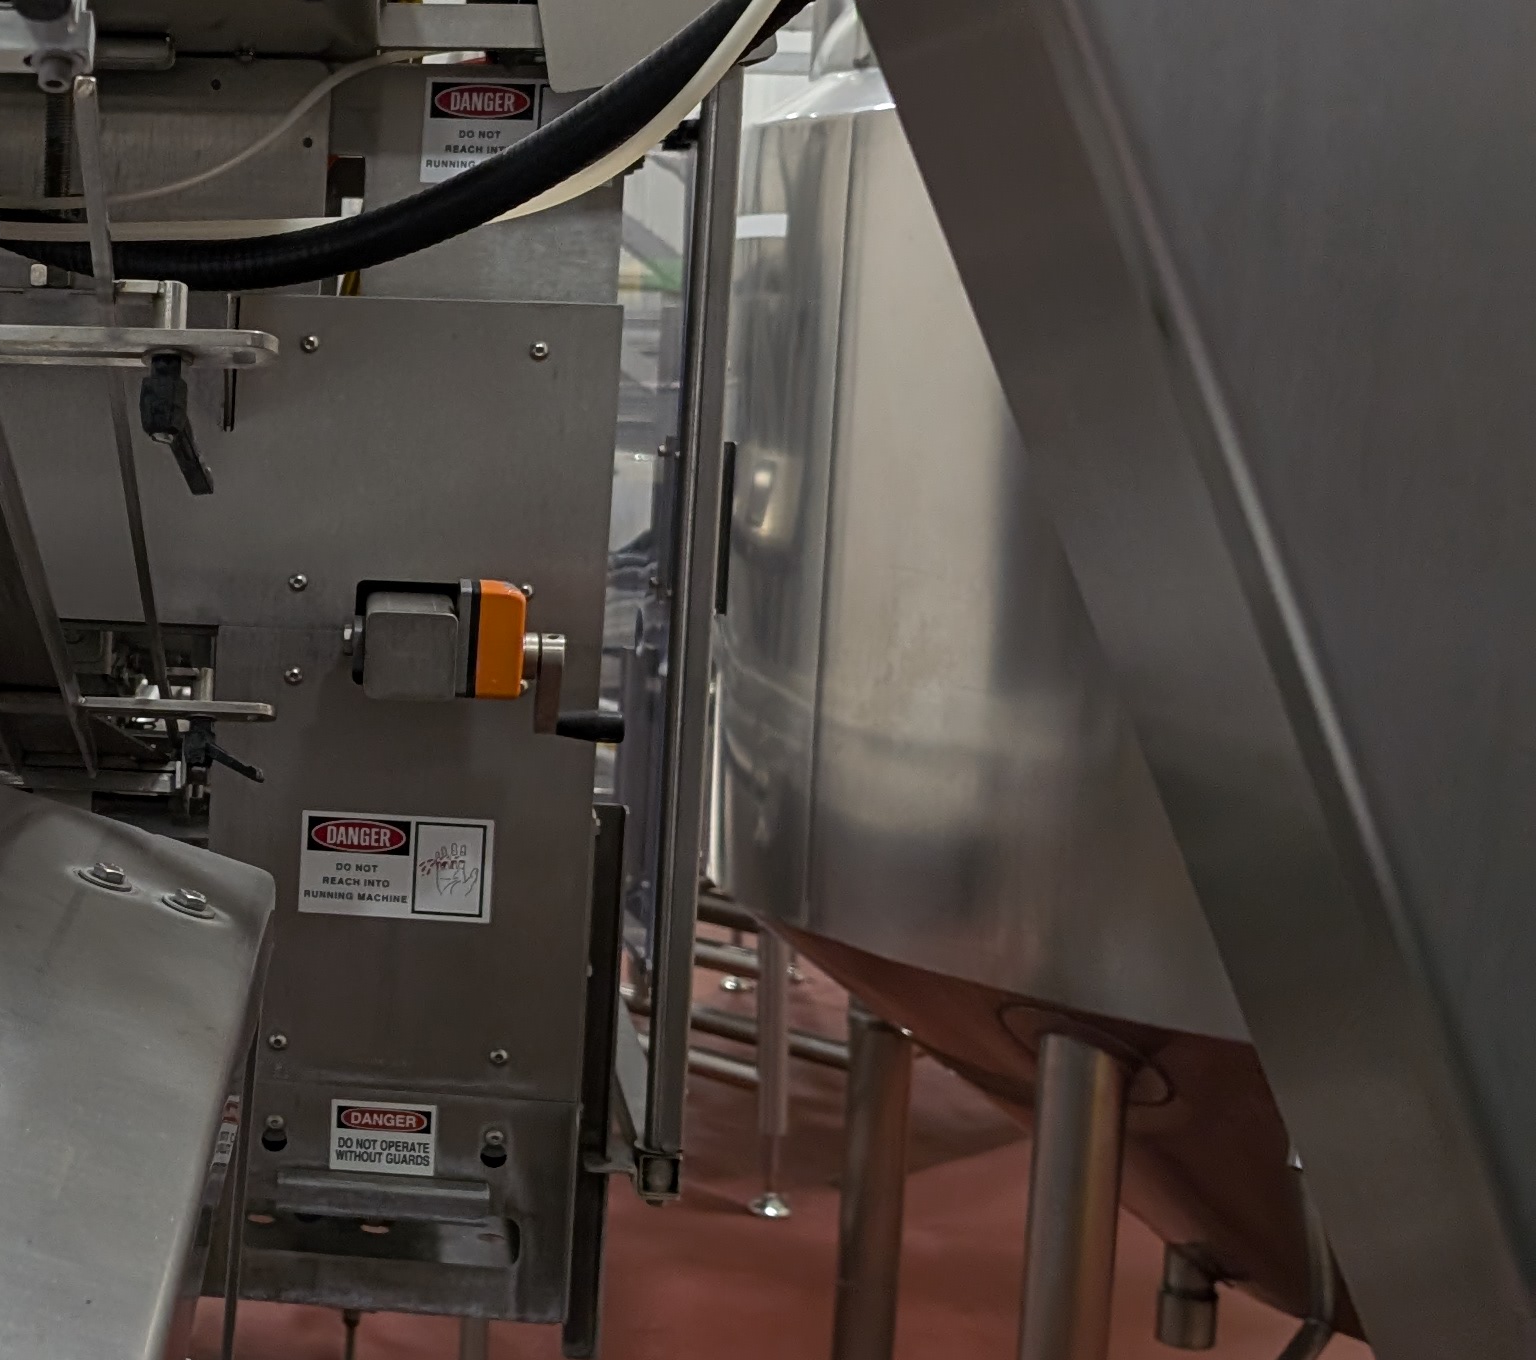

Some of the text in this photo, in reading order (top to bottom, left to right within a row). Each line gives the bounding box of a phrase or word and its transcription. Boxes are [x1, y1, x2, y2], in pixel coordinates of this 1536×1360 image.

[450, 91, 514, 112] DANGER
[459, 130, 500, 139] DO NOT
[445, 144, 506, 154] REACH INT
[426, 159, 475, 169] RUNNING
[326, 825, 391, 847] DANGER
[335, 862, 378, 873] DO NOT
[322, 877, 390, 888] REACH INTO
[304, 890, 408, 904] RUNNING MACHINE
[350, 1112, 417, 1128] DANGER
[338, 1137, 430, 1154] DO NOT OPERATE
[335, 1149, 430, 1166] WITHOUT GUARDS
